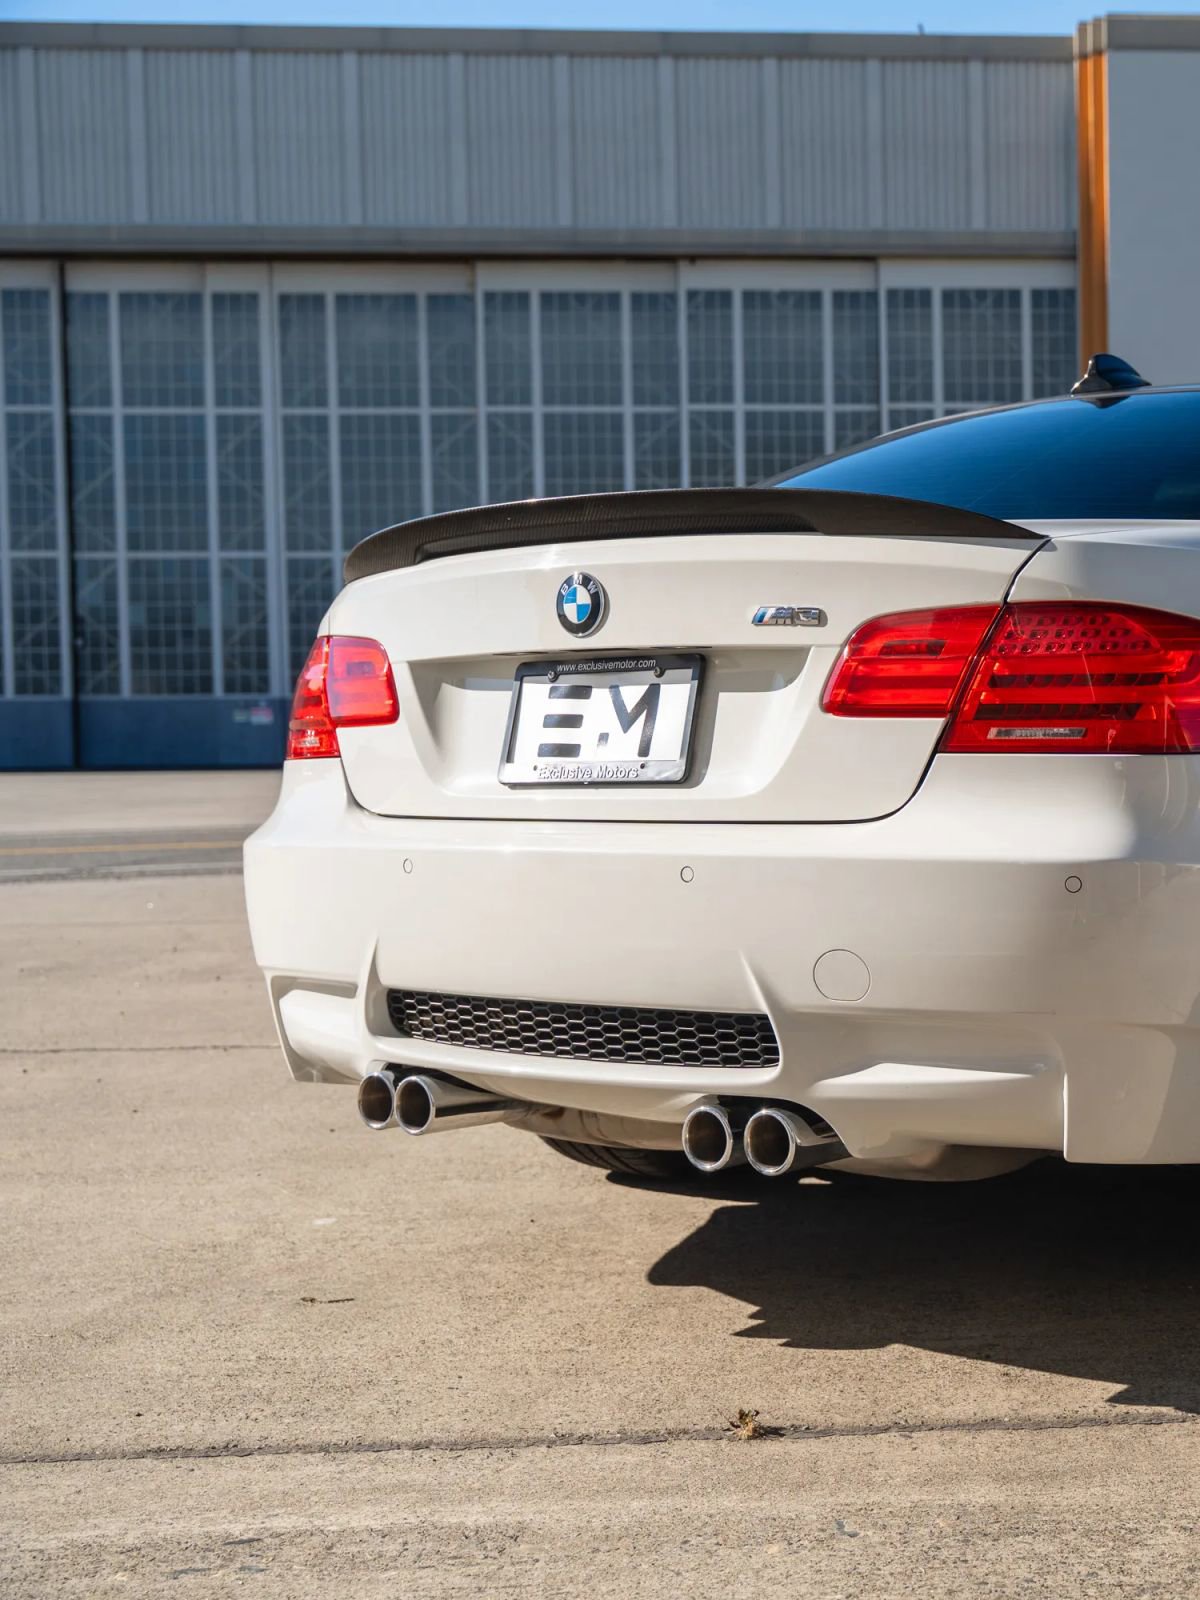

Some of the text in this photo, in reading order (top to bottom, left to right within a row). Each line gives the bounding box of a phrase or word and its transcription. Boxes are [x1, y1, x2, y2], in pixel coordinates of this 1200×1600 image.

[560, 574, 598, 596] BMW
[754, 606, 824, 626] M3
[556, 658, 657, 672] www.exclusivemotor.com
[538, 764, 640, 780] Exclusive Motors
